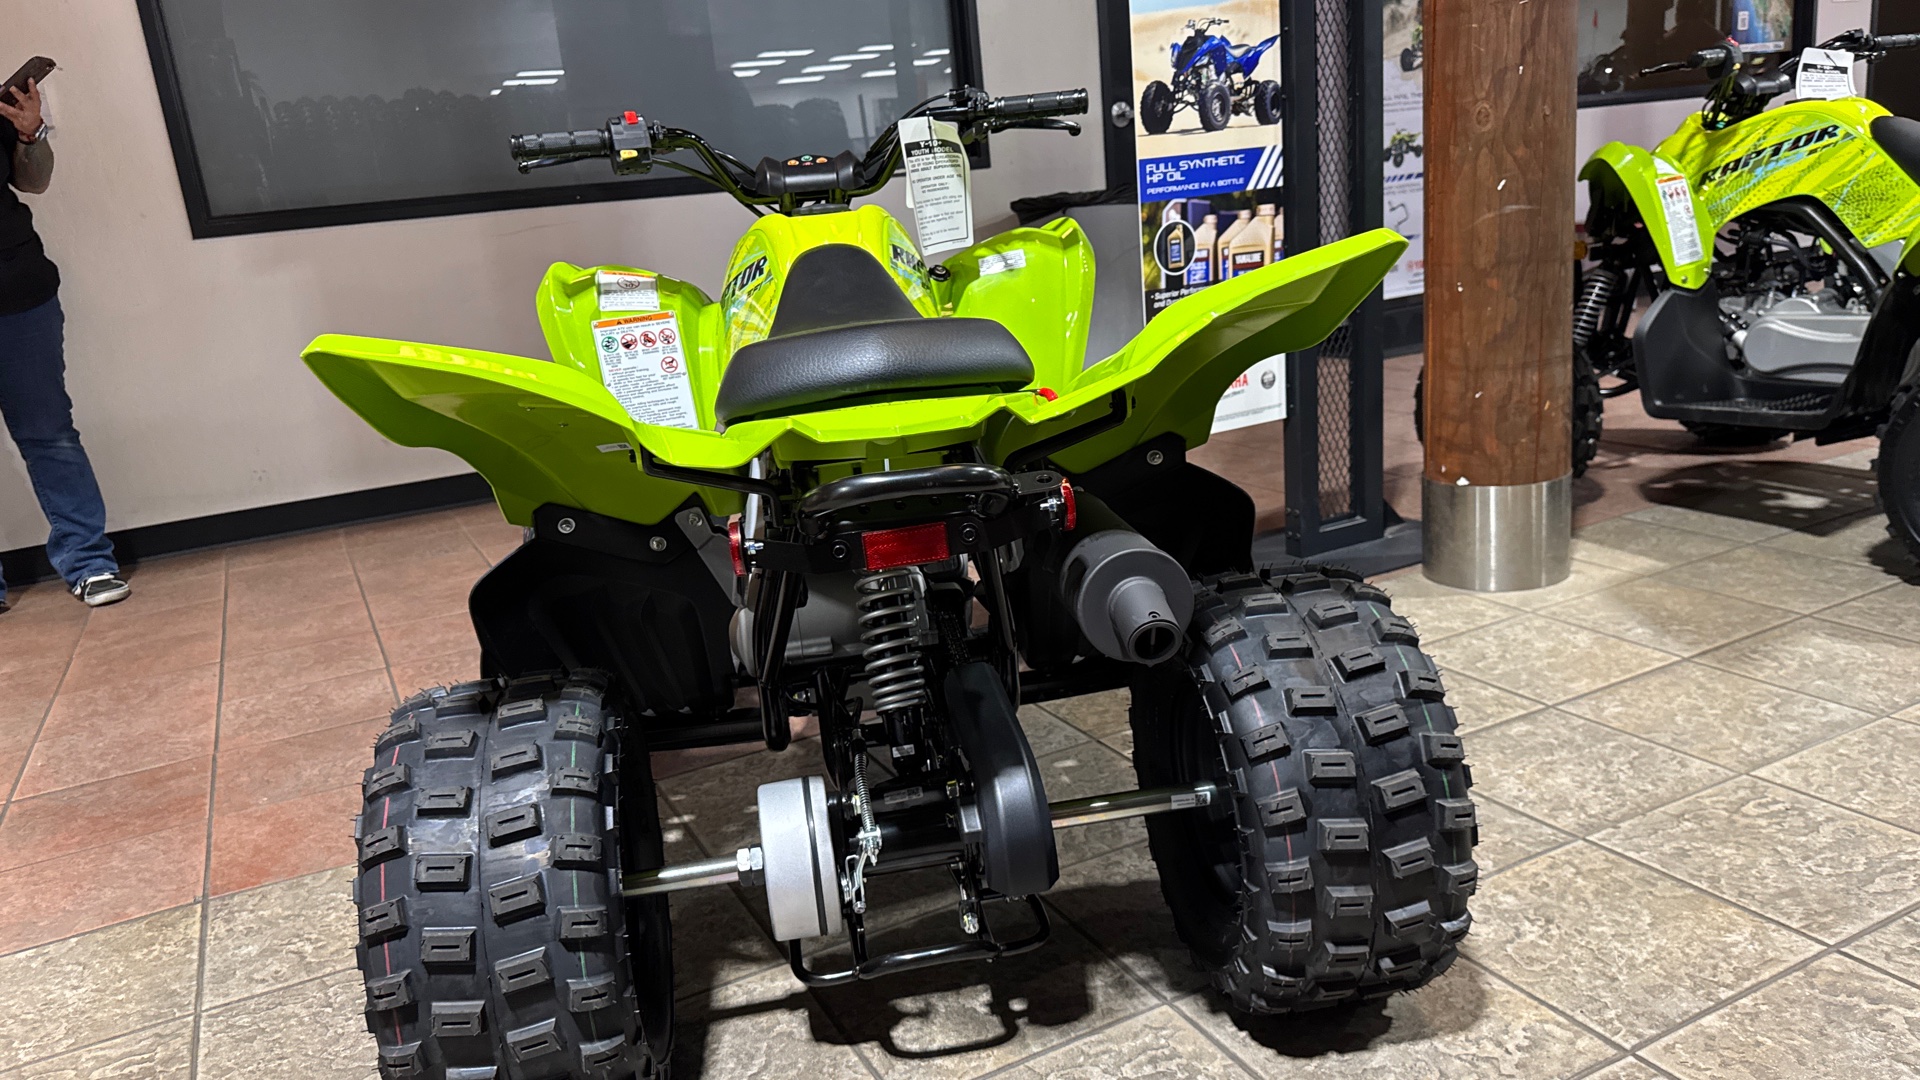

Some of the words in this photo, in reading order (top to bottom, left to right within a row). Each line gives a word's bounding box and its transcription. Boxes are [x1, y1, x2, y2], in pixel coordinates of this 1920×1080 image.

[911, 148, 929, 156] YOUTH
[1699, 124, 1840, 186] RAPTOR
[1146, 162, 1176, 173] FULL
[1179, 154, 1245, 170] SYNTHETIC
[1146, 173, 1164, 184] HP
[1167, 171, 1185, 181] OIL
[1147, 183, 1199, 195] PERFORMANCE
[1217, 178, 1244, 186] BOTTLE
[1155, 289, 1179, 300] Superior
[1154, 300, 1165, 308] and
